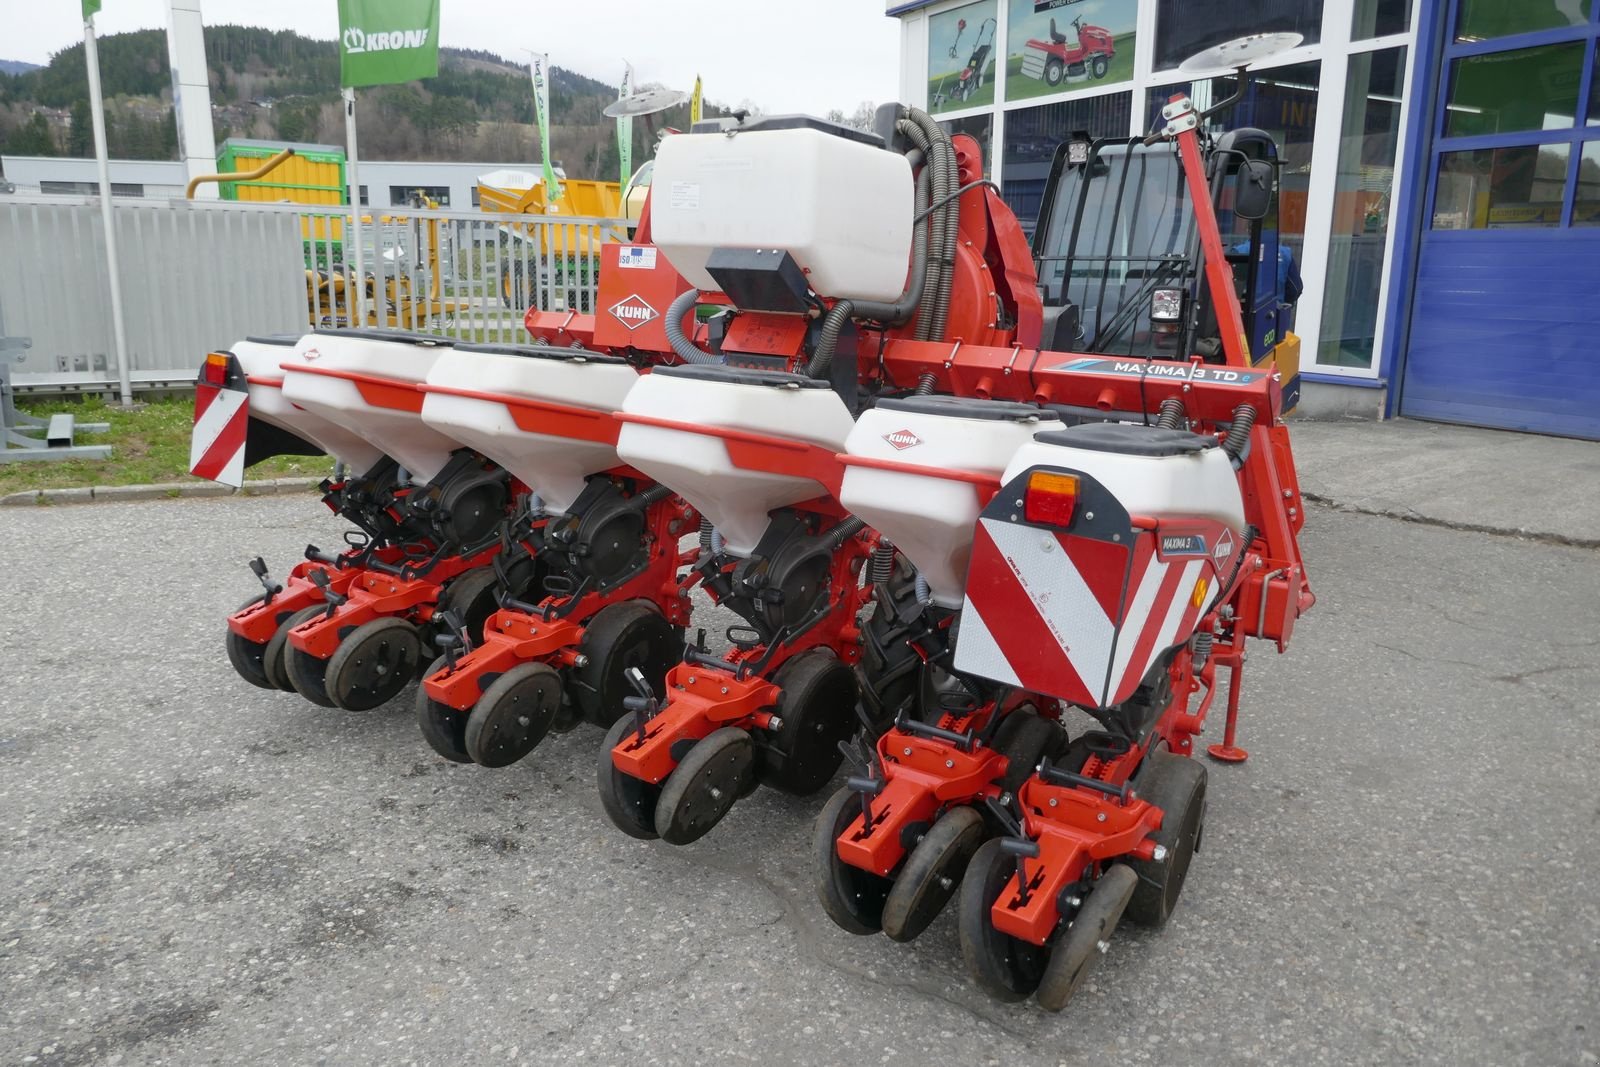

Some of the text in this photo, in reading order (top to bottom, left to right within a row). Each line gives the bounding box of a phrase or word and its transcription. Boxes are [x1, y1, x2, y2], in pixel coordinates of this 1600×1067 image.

[616, 305, 651, 320] KUHN
[1114, 361, 1186, 377] MAXIMA
[1193, 368, 1205, 378] 3
[1212, 370, 1239, 381] TD
[889, 433, 918, 445] KUHN
[1163, 537, 1191, 549] MAXIMA 3
